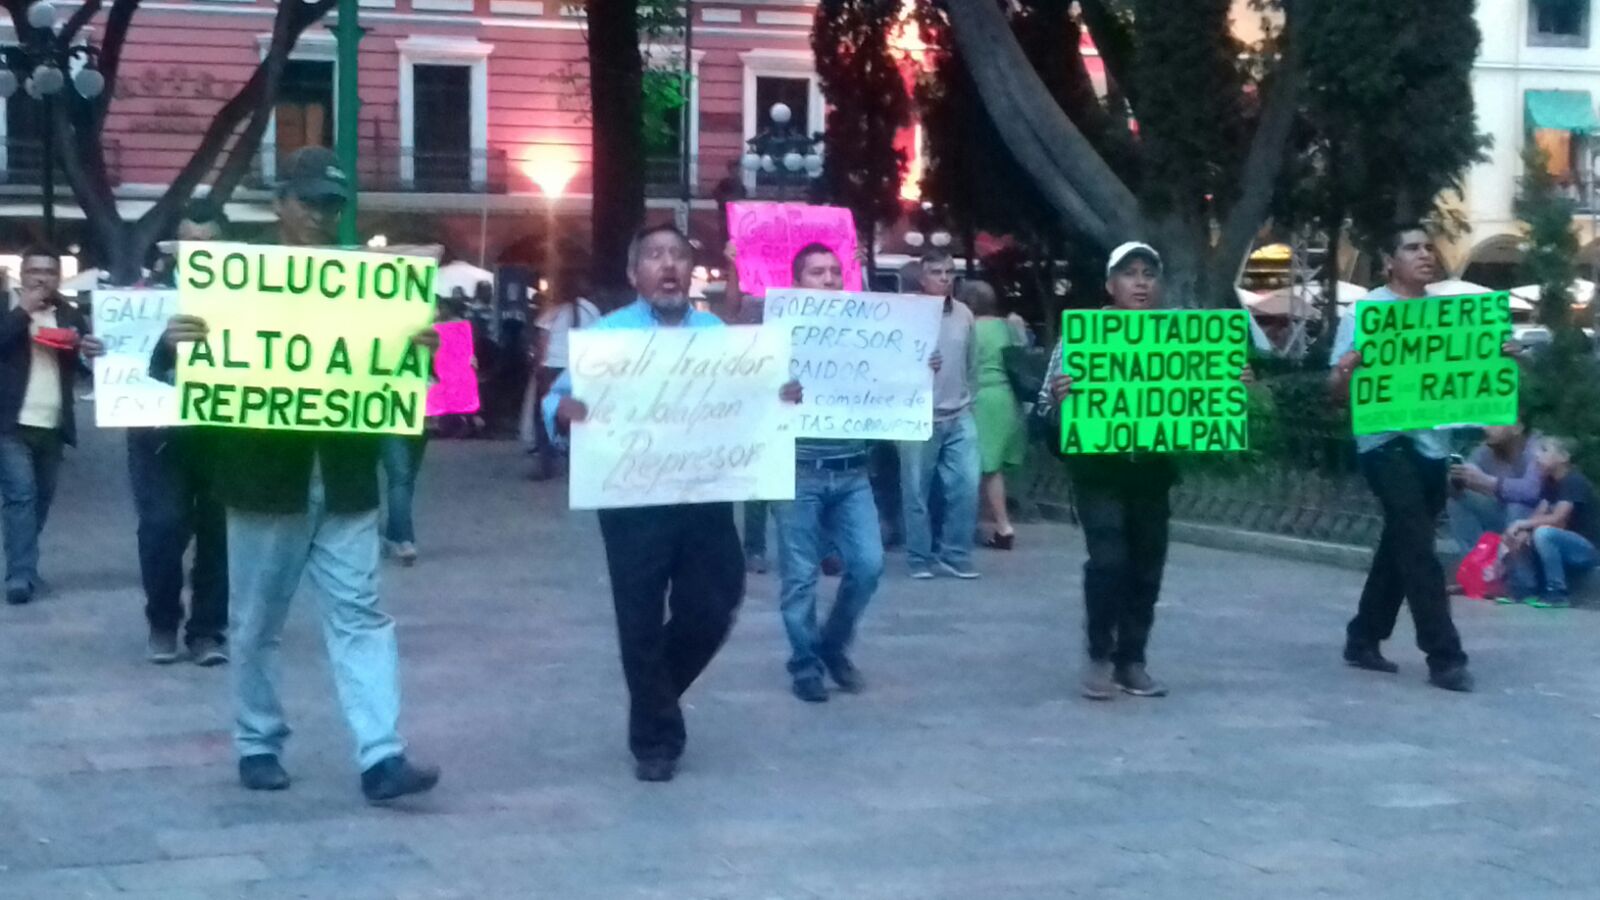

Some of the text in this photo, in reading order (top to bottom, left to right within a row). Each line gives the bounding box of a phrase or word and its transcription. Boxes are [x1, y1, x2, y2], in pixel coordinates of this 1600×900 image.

[188, 249, 434, 303] SOLUCIÓN
[770, 296, 890, 321] GOBIERNO
[790, 325, 904, 352] EPRESOR
[1067, 313, 1247, 345] DIPUTADOS
[188, 328, 312, 372] ALTO
[326, 336, 352, 375] A
[370, 337, 423, 379] LA
[1067, 350, 1246, 383] SENADORES
[1069, 386, 1246, 419] TRAIDORES
[1357, 367, 1516, 405] DE RATAS
[180, 380, 418, 430] REPRESIÓN
[1064, 419, 1247, 454] A JOLALPAN
